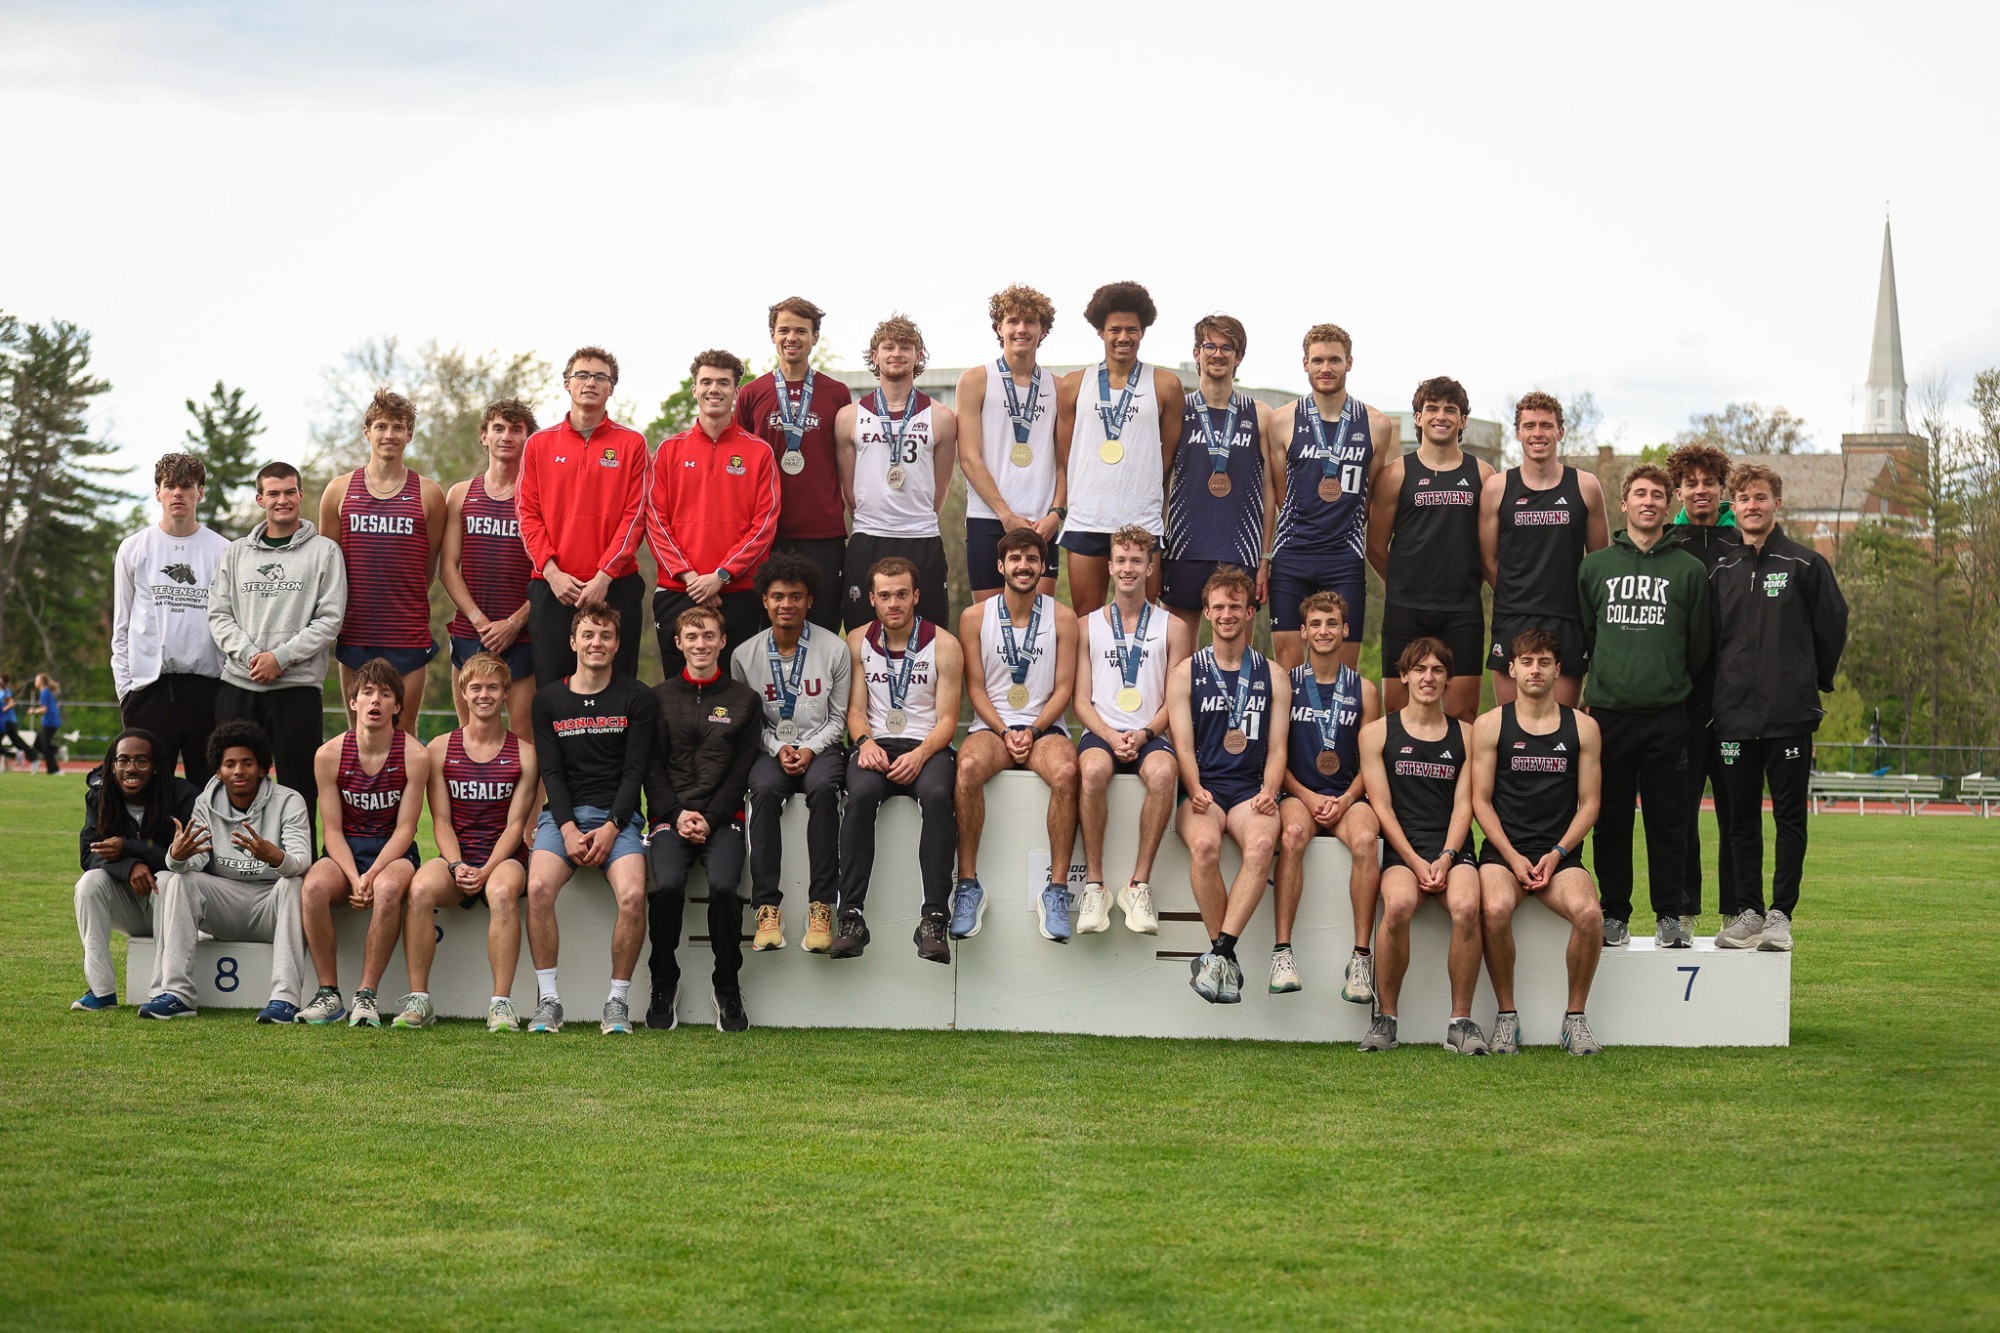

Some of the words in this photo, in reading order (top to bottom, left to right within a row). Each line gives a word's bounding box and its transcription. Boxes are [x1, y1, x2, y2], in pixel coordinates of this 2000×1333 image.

[902, 439, 918, 464] 3
[1414, 491, 1474, 506] STEVENS
[349, 514, 414, 535] DESALES
[466, 516, 520, 537] DESALE
[1514, 511, 1570, 526] STEVENS
[241, 581, 303, 593] STEVENSON
[1606, 575, 1670, 605] YORK
[1763, 580, 1788, 589] YORK
[1606, 604, 1666, 625] COLLEGE
[553, 716, 629, 732] MONARCH
[558, 729, 586, 738] CROSS
[588, 727, 625, 735] COUNTRY
[1395, 760, 1456, 779] STEVENS
[1511, 756, 1568, 772] STEVENS
[448, 779, 514, 800] DESALES
[214, 956, 240, 993] 8
[1676, 966, 1701, 1001] 7
